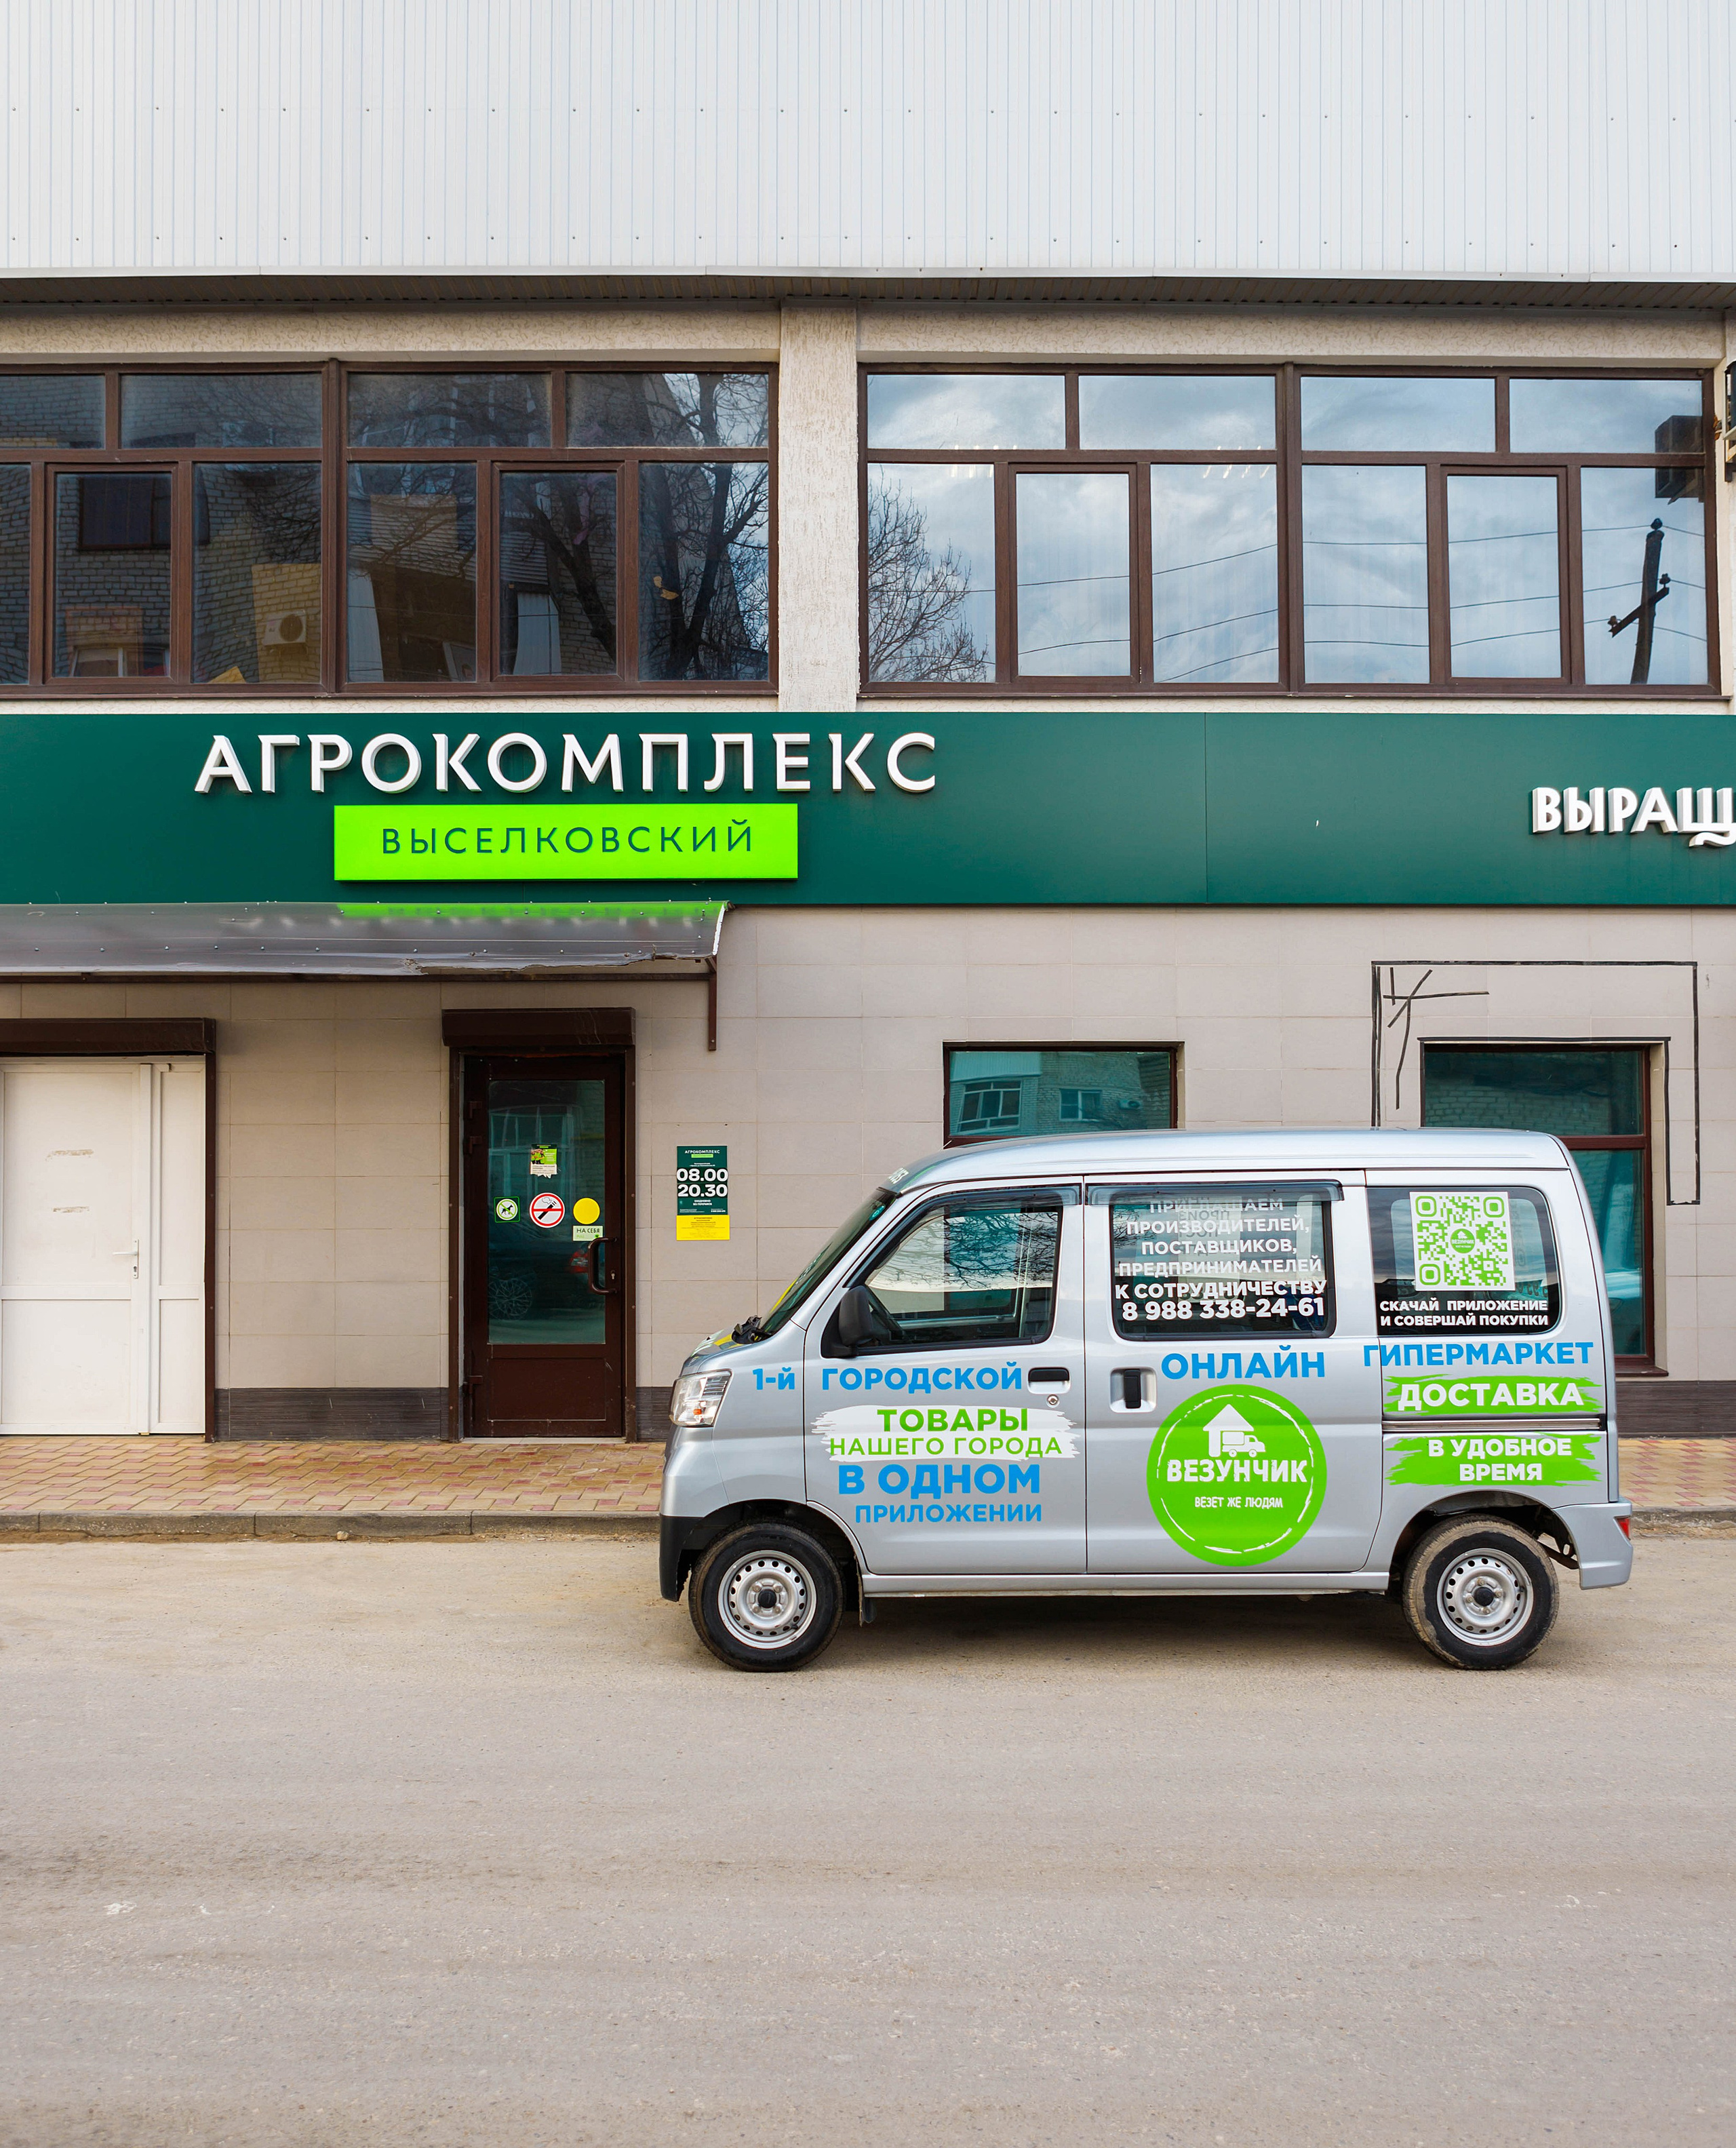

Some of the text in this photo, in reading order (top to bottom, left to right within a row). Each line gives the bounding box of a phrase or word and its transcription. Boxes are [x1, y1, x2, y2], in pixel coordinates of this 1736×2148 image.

[194, 733, 936, 794] АГРОКОМПЛЕКС
[382, 819, 752, 855] ВЫСЕЛКОВСКИЙ
[676, 1168, 728, 1182] 08.00
[677, 1184, 728, 1197] 20.30
[1126, 1214, 1309, 1235] ПРОИЗВОДИТЕЛЕЙ,
[1141, 1238, 1297, 1255] ПОСТАВЩИКОВ,
[1118, 1255, 1322, 1278] ПРЕДПРИНИМАТЕЛЕЙ
[1115, 1279, 1327, 1300] К СОТРУДНИЧЕСТВУ
[1122, 1297, 1325, 1321] 8 988 338-24-61
[1379, 1297, 1548, 1312] СКАЧАЙ ПРИЛОЖЕНИЕ
[1380, 1312, 1549, 1327] И СОВЕРШАЙ ПОКУПКИ
[822, 1361, 1023, 1394] ГОРОДСКОЙ
[1161, 1344, 1326, 1380] ОНЛАЙН
[1363, 1342, 1594, 1367] ГИПЕРМАРКЕТ
[1398, 1382, 1584, 1411] ДОСТАВКА
[877, 1408, 1028, 1432] ТОВАРЫ
[830, 1437, 1063, 1458] НАШЕГО ГОРОДА
[1428, 1439, 1572, 1460] В УДОБНОЕ
[838, 1464, 1040, 1500] В ОДНОМ
[1166, 1460, 1307, 1483] ВЕЗУНЧИК
[1459, 1463, 1543, 1481] ВРЕМЯ
[855, 1503, 1042, 1524] ПРИЛОЖЕНИИ
[1194, 1496, 1284, 1510] ВЕЗЕТ ЖЕ ЛЮДЯМ
